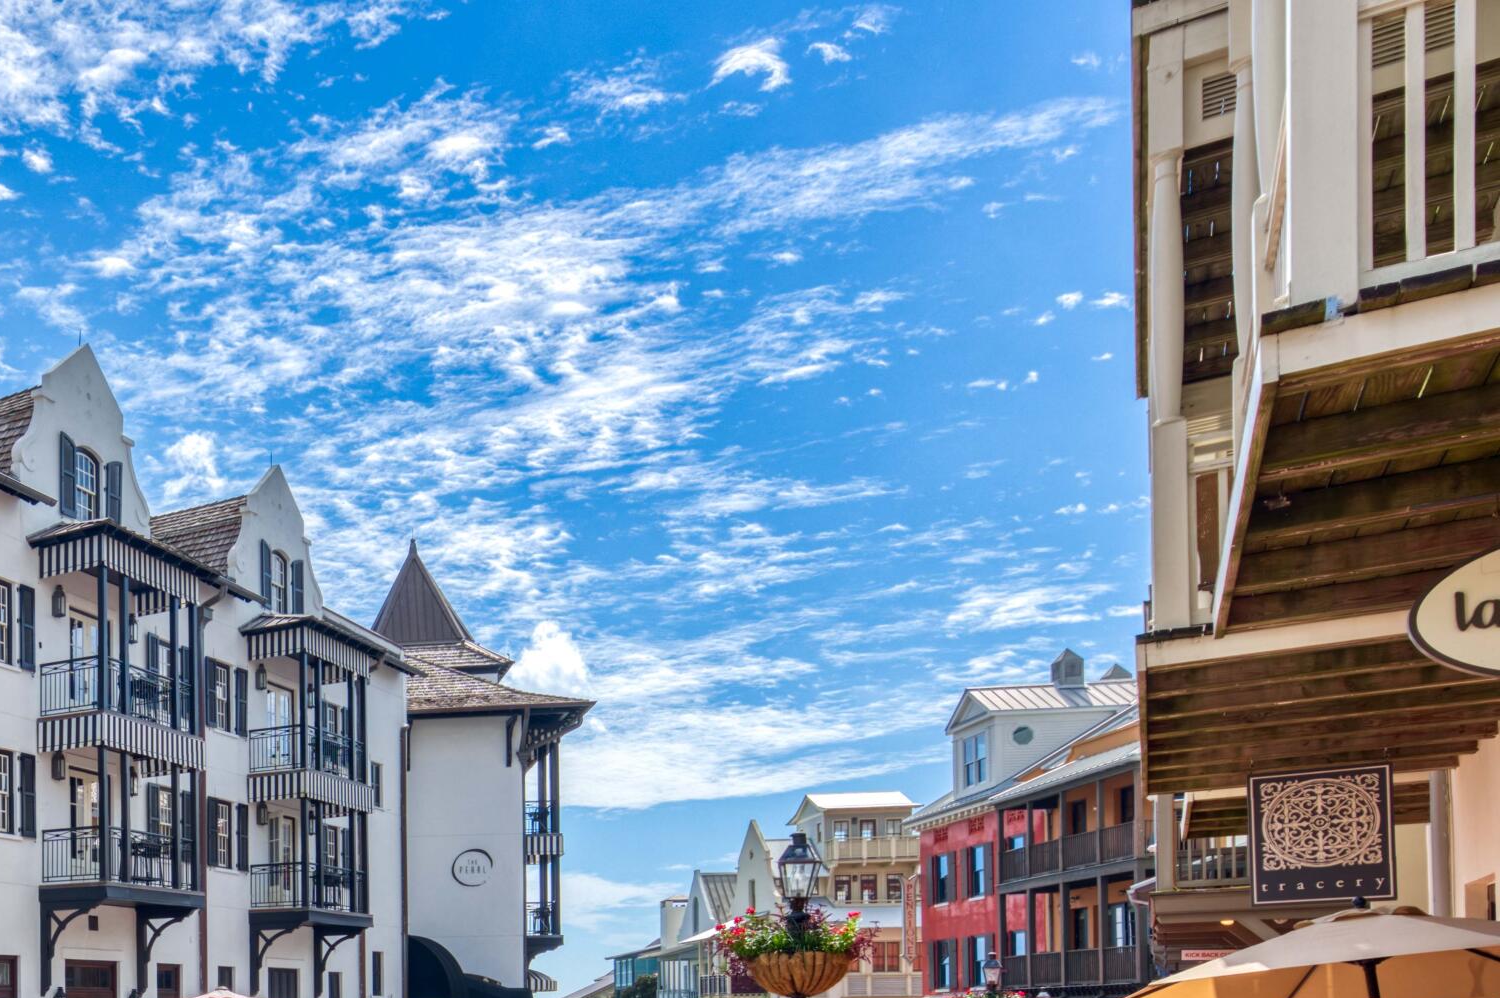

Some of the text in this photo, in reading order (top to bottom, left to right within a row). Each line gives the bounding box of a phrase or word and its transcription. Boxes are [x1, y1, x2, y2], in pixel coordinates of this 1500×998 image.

[1455, 591, 1500, 632] la
[459, 865, 486, 874] PEARL
[1261, 877, 1385, 892] tracery
[906, 883, 915, 955] PENSIONE
